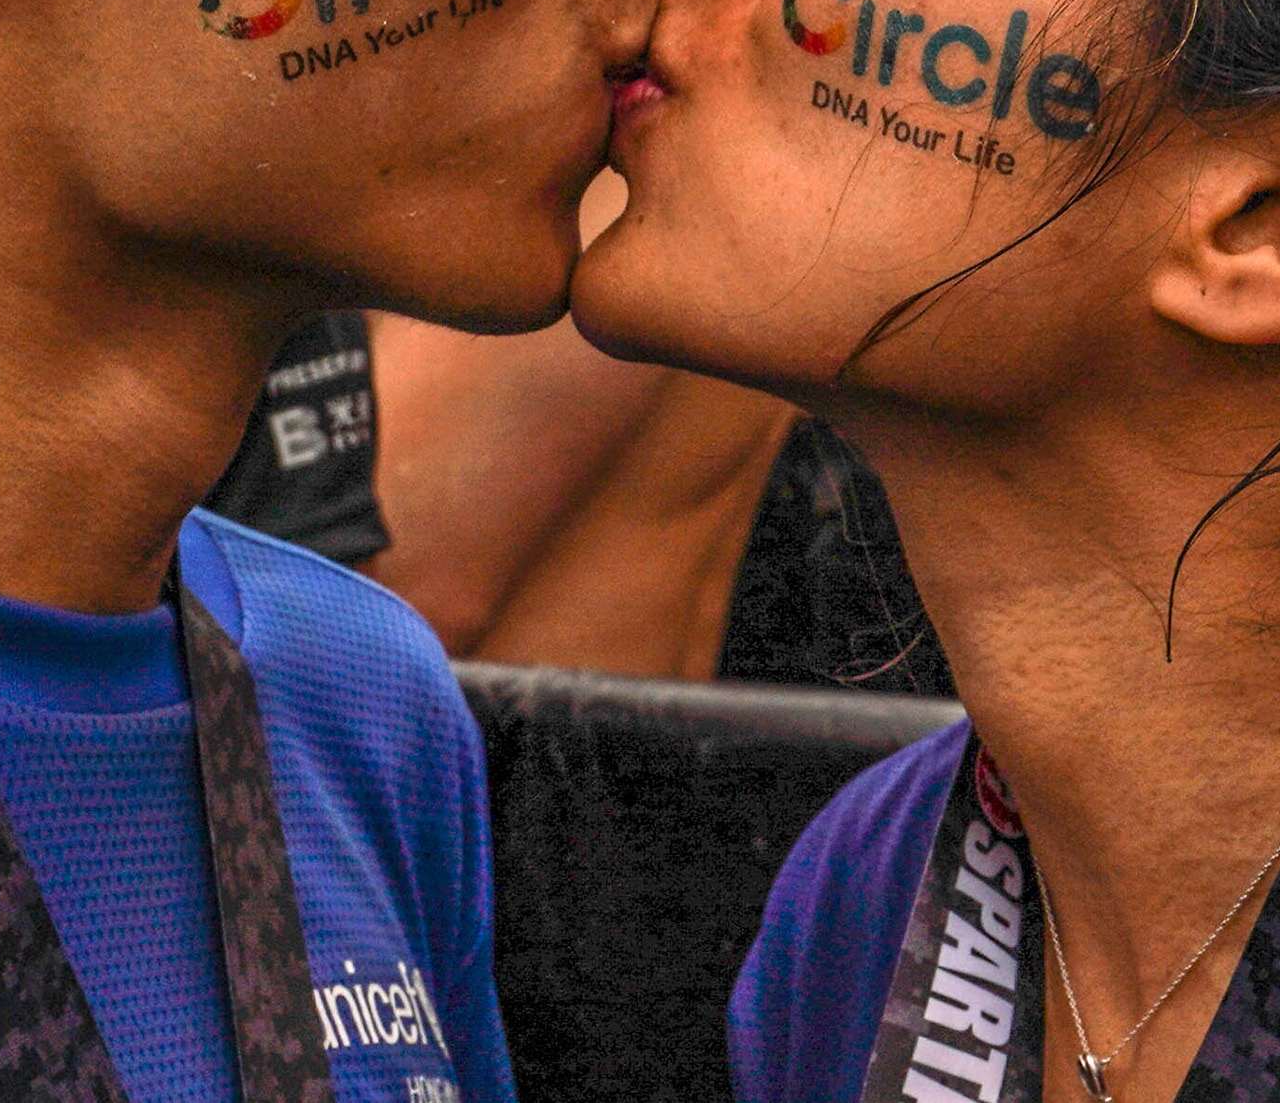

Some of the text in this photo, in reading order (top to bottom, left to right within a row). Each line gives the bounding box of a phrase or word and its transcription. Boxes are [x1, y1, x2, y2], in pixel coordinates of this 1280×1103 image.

[280, 38, 358, 81] DNA
[365, 10, 440, 55] Your
[811, 81, 1016, 176] DNA Your Life
